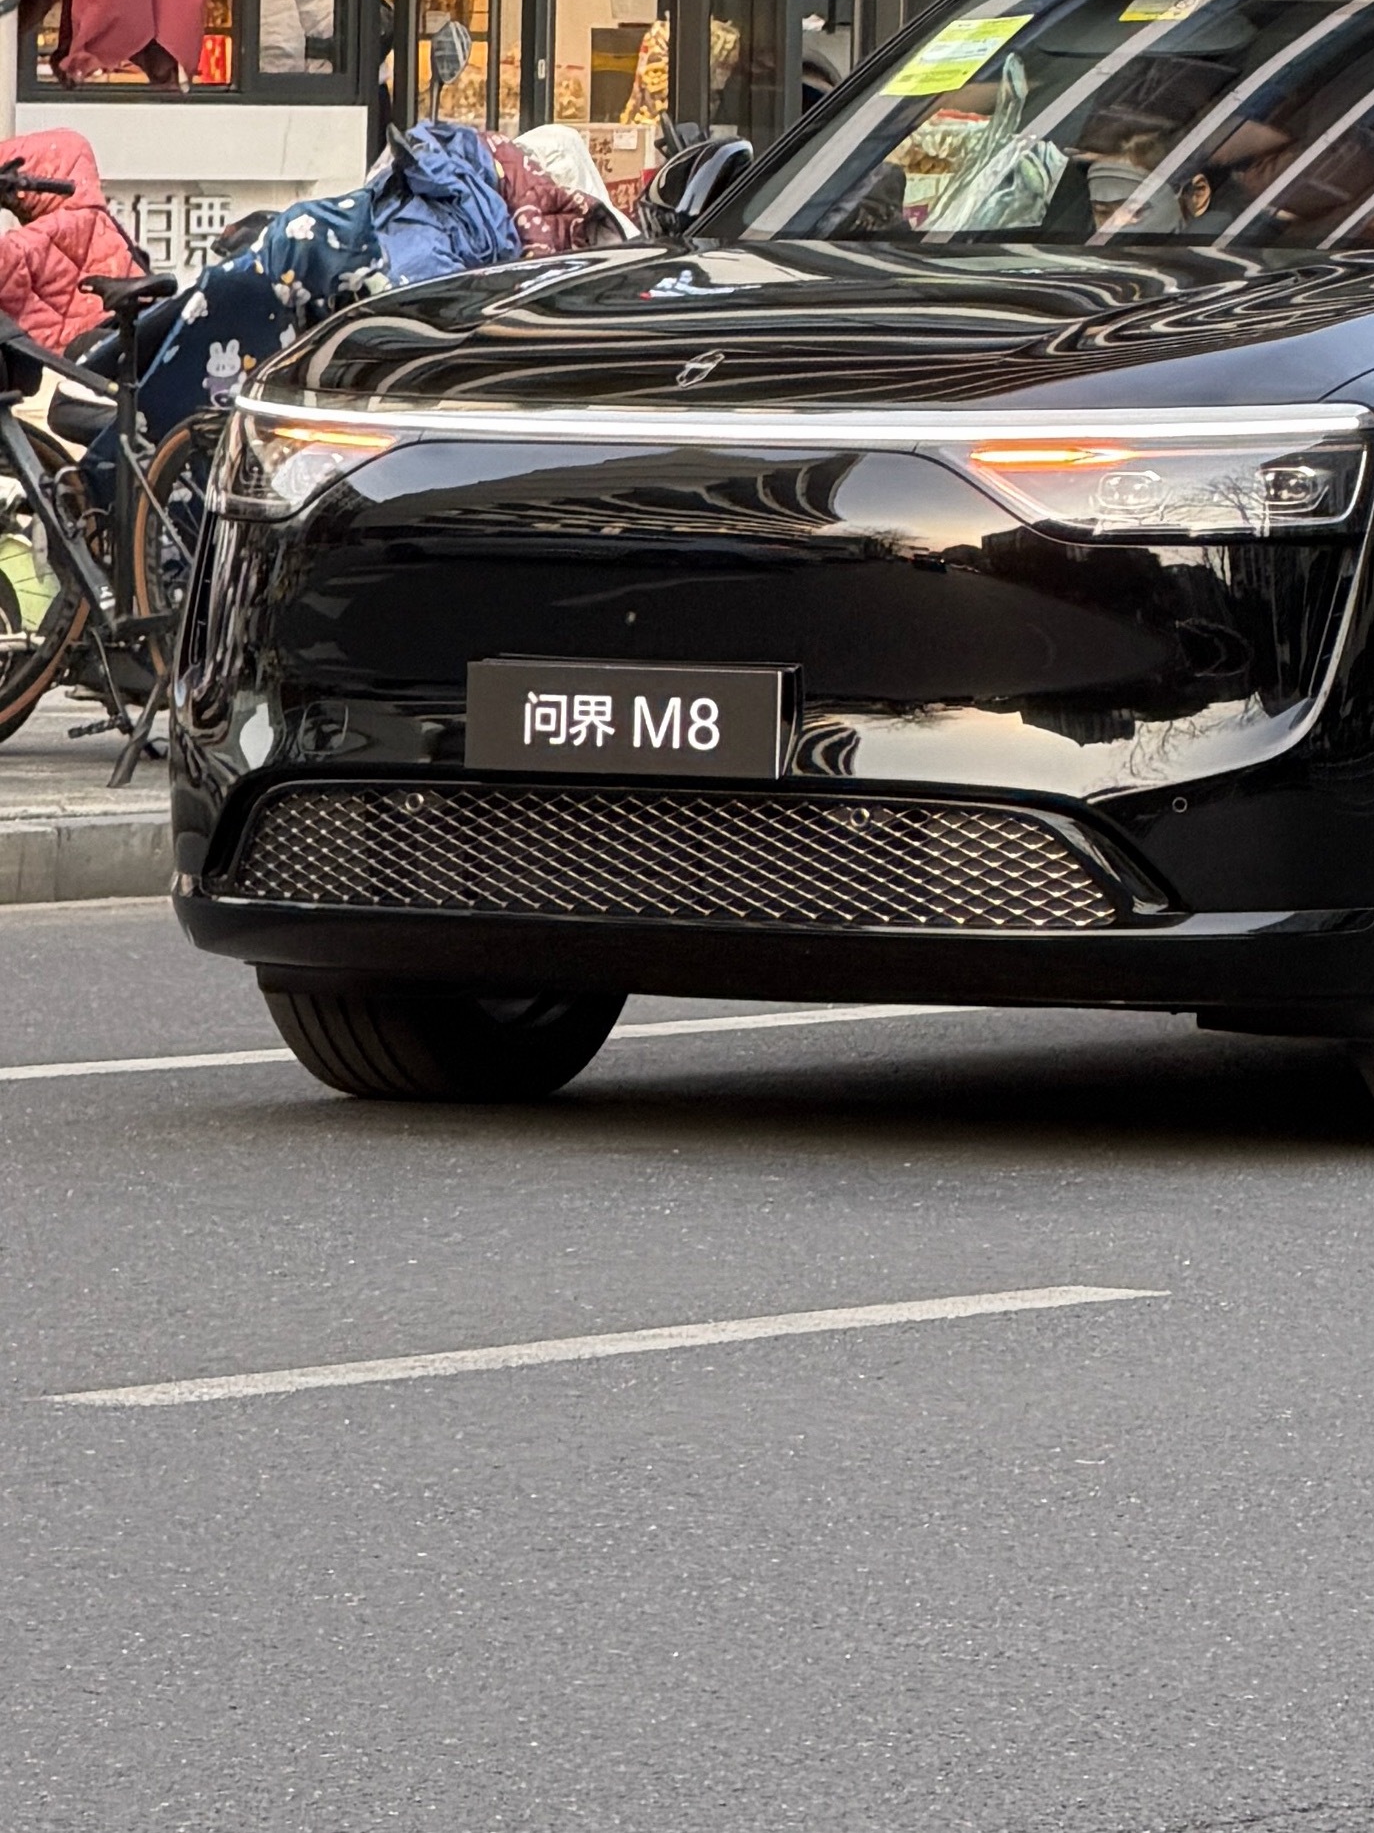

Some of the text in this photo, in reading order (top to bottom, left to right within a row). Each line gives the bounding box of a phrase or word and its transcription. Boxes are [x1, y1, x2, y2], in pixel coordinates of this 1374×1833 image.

[107, 194, 233, 269] 甘栗
[524, 691, 720, 750] 问界 M8
